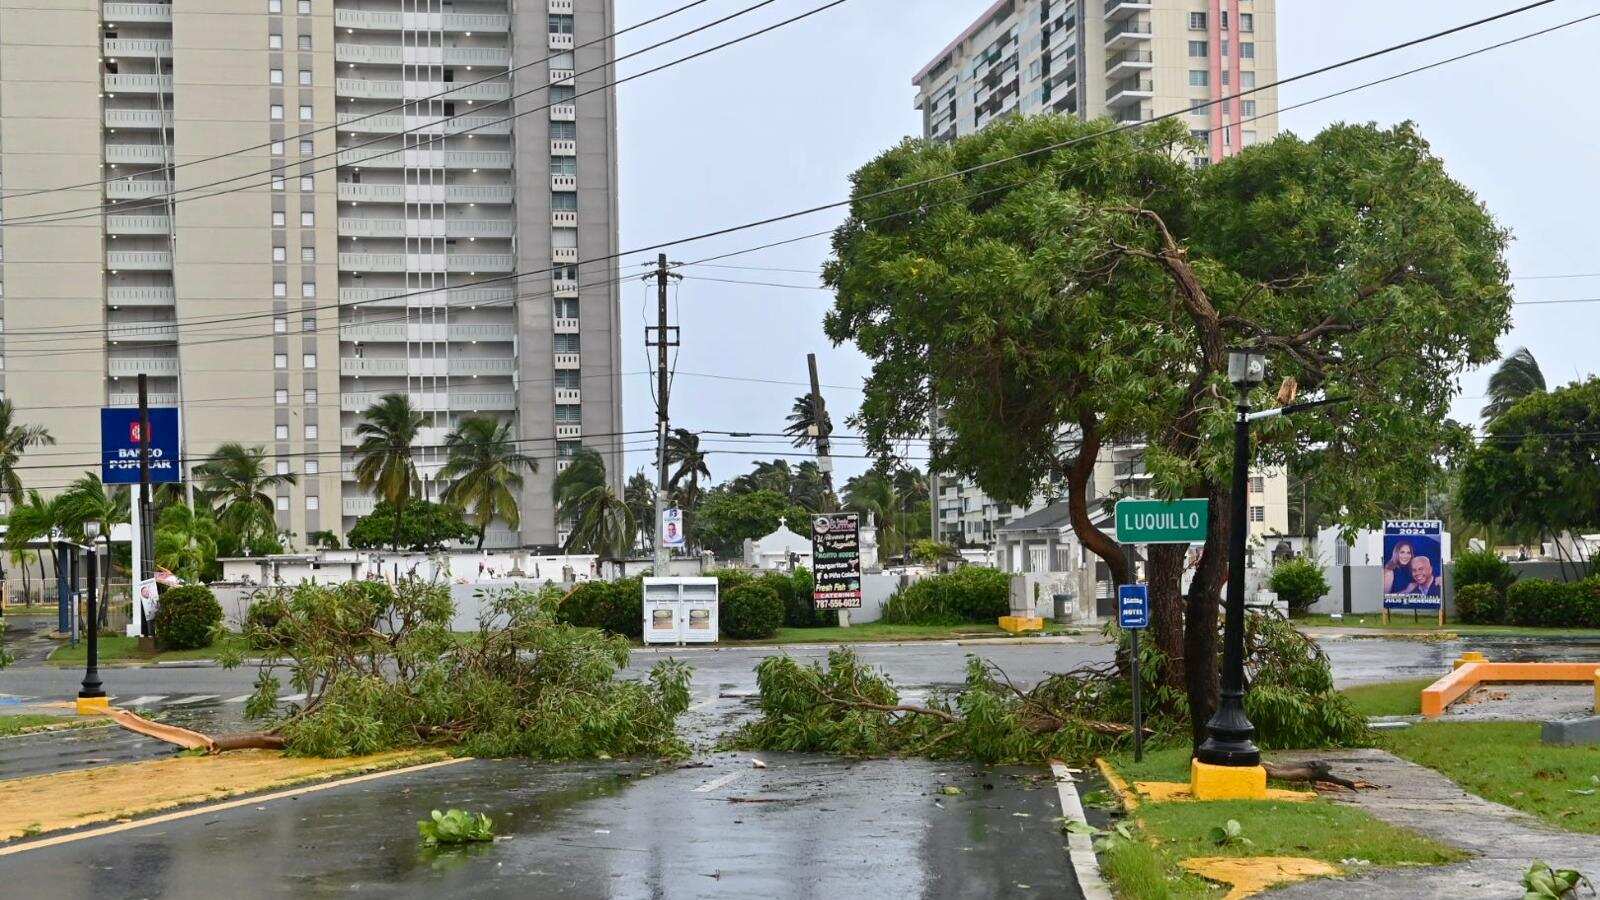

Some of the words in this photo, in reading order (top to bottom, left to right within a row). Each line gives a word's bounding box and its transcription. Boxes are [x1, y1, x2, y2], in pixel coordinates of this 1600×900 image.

[1124, 512, 1199, 531] LUQUILLO
[1400, 528, 1425, 536] 2024
[816, 583, 833, 591] Fresh
[834, 583, 847, 591] Fish
